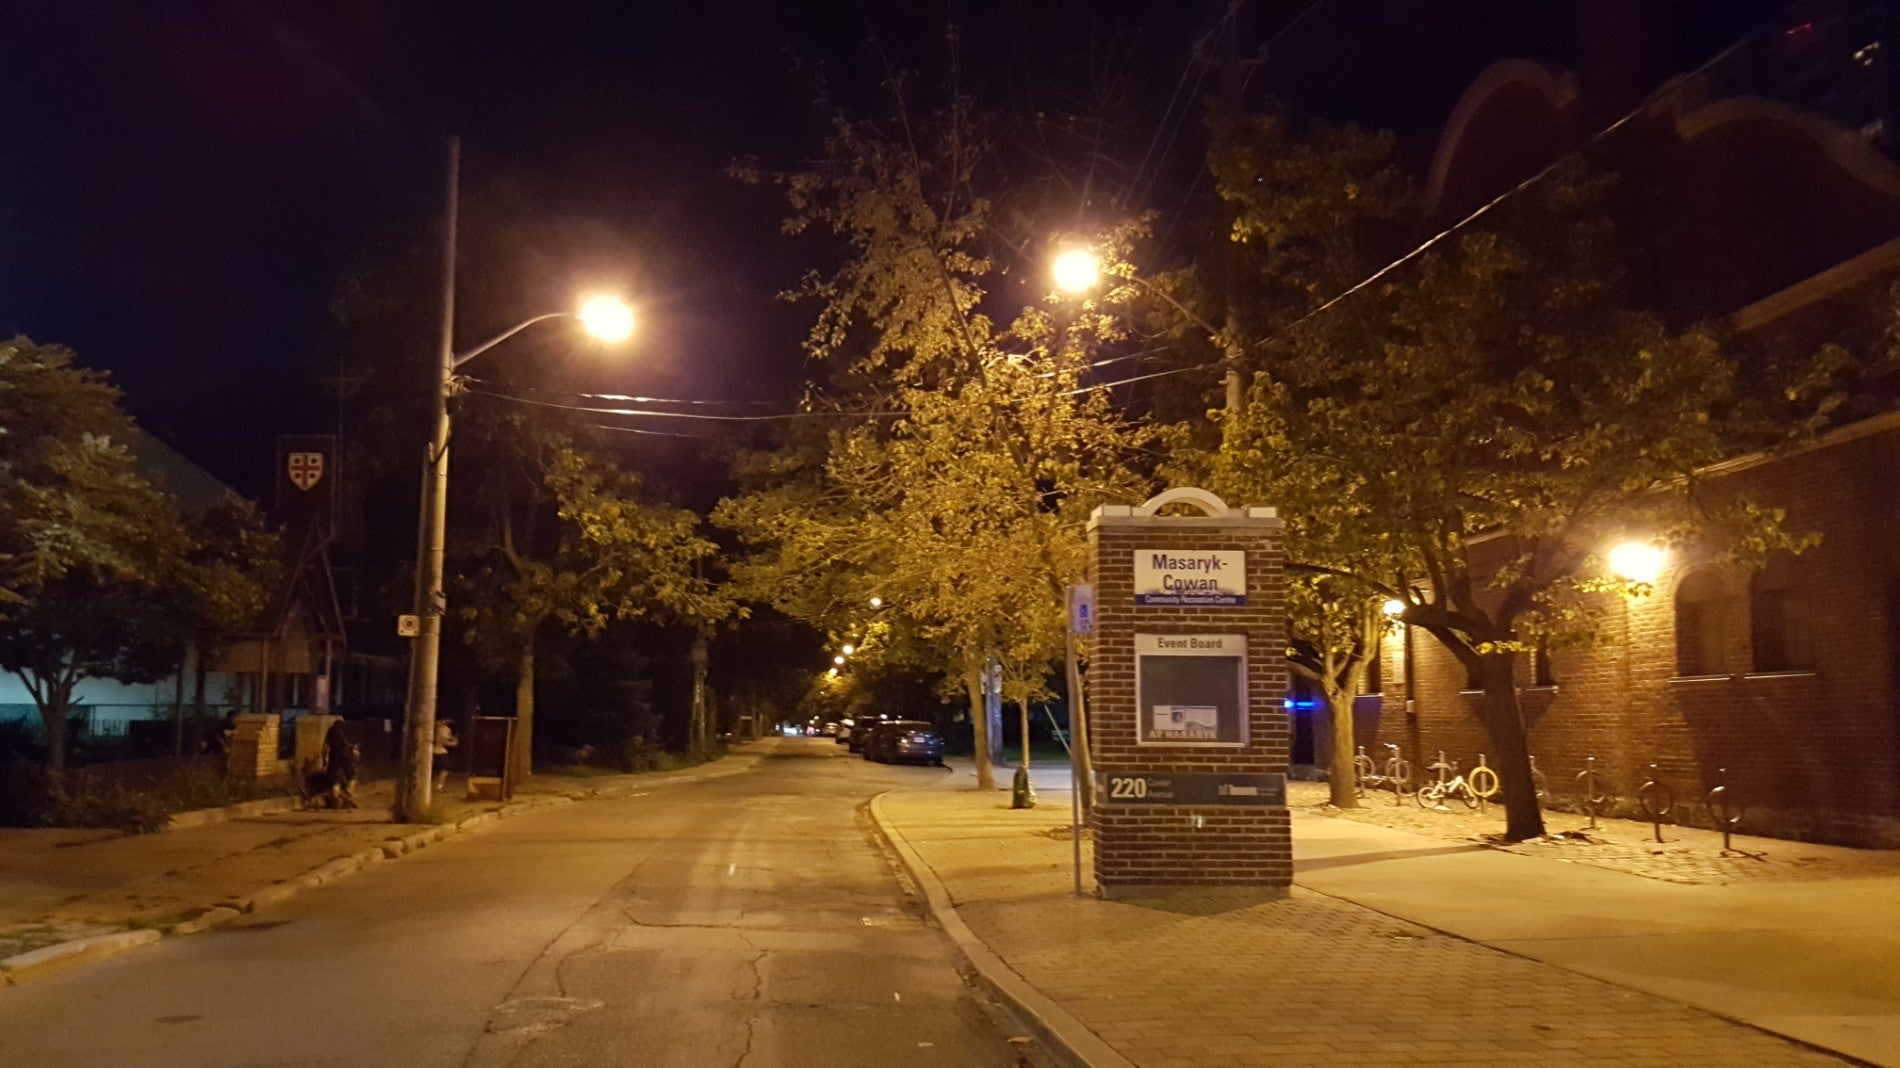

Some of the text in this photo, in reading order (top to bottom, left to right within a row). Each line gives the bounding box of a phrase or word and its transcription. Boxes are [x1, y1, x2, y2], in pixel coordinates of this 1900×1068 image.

[1152, 554, 1228, 574] Masaryk-
[1163, 574, 1218, 591] Cowan
[1157, 637, 1222, 648] Event Board
[1111, 777, 1147, 798] 220
